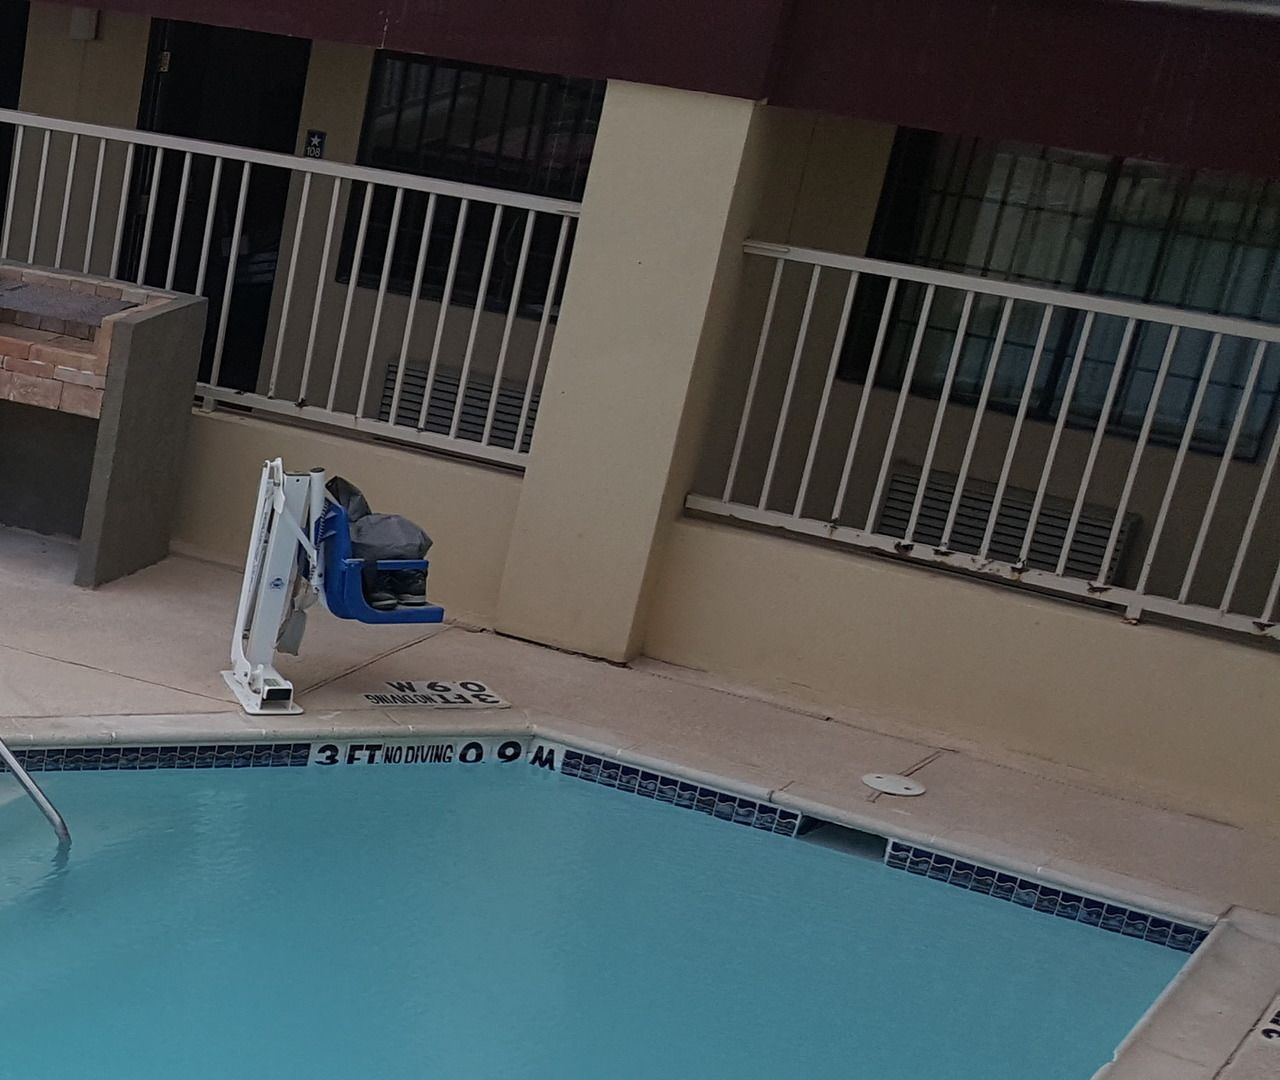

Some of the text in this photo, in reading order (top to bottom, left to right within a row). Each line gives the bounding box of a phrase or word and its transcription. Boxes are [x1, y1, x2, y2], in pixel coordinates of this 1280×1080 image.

[306, 146, 320, 158] 108
[384, 746, 401, 764] NO
[404, 744, 453, 763] DIVING
